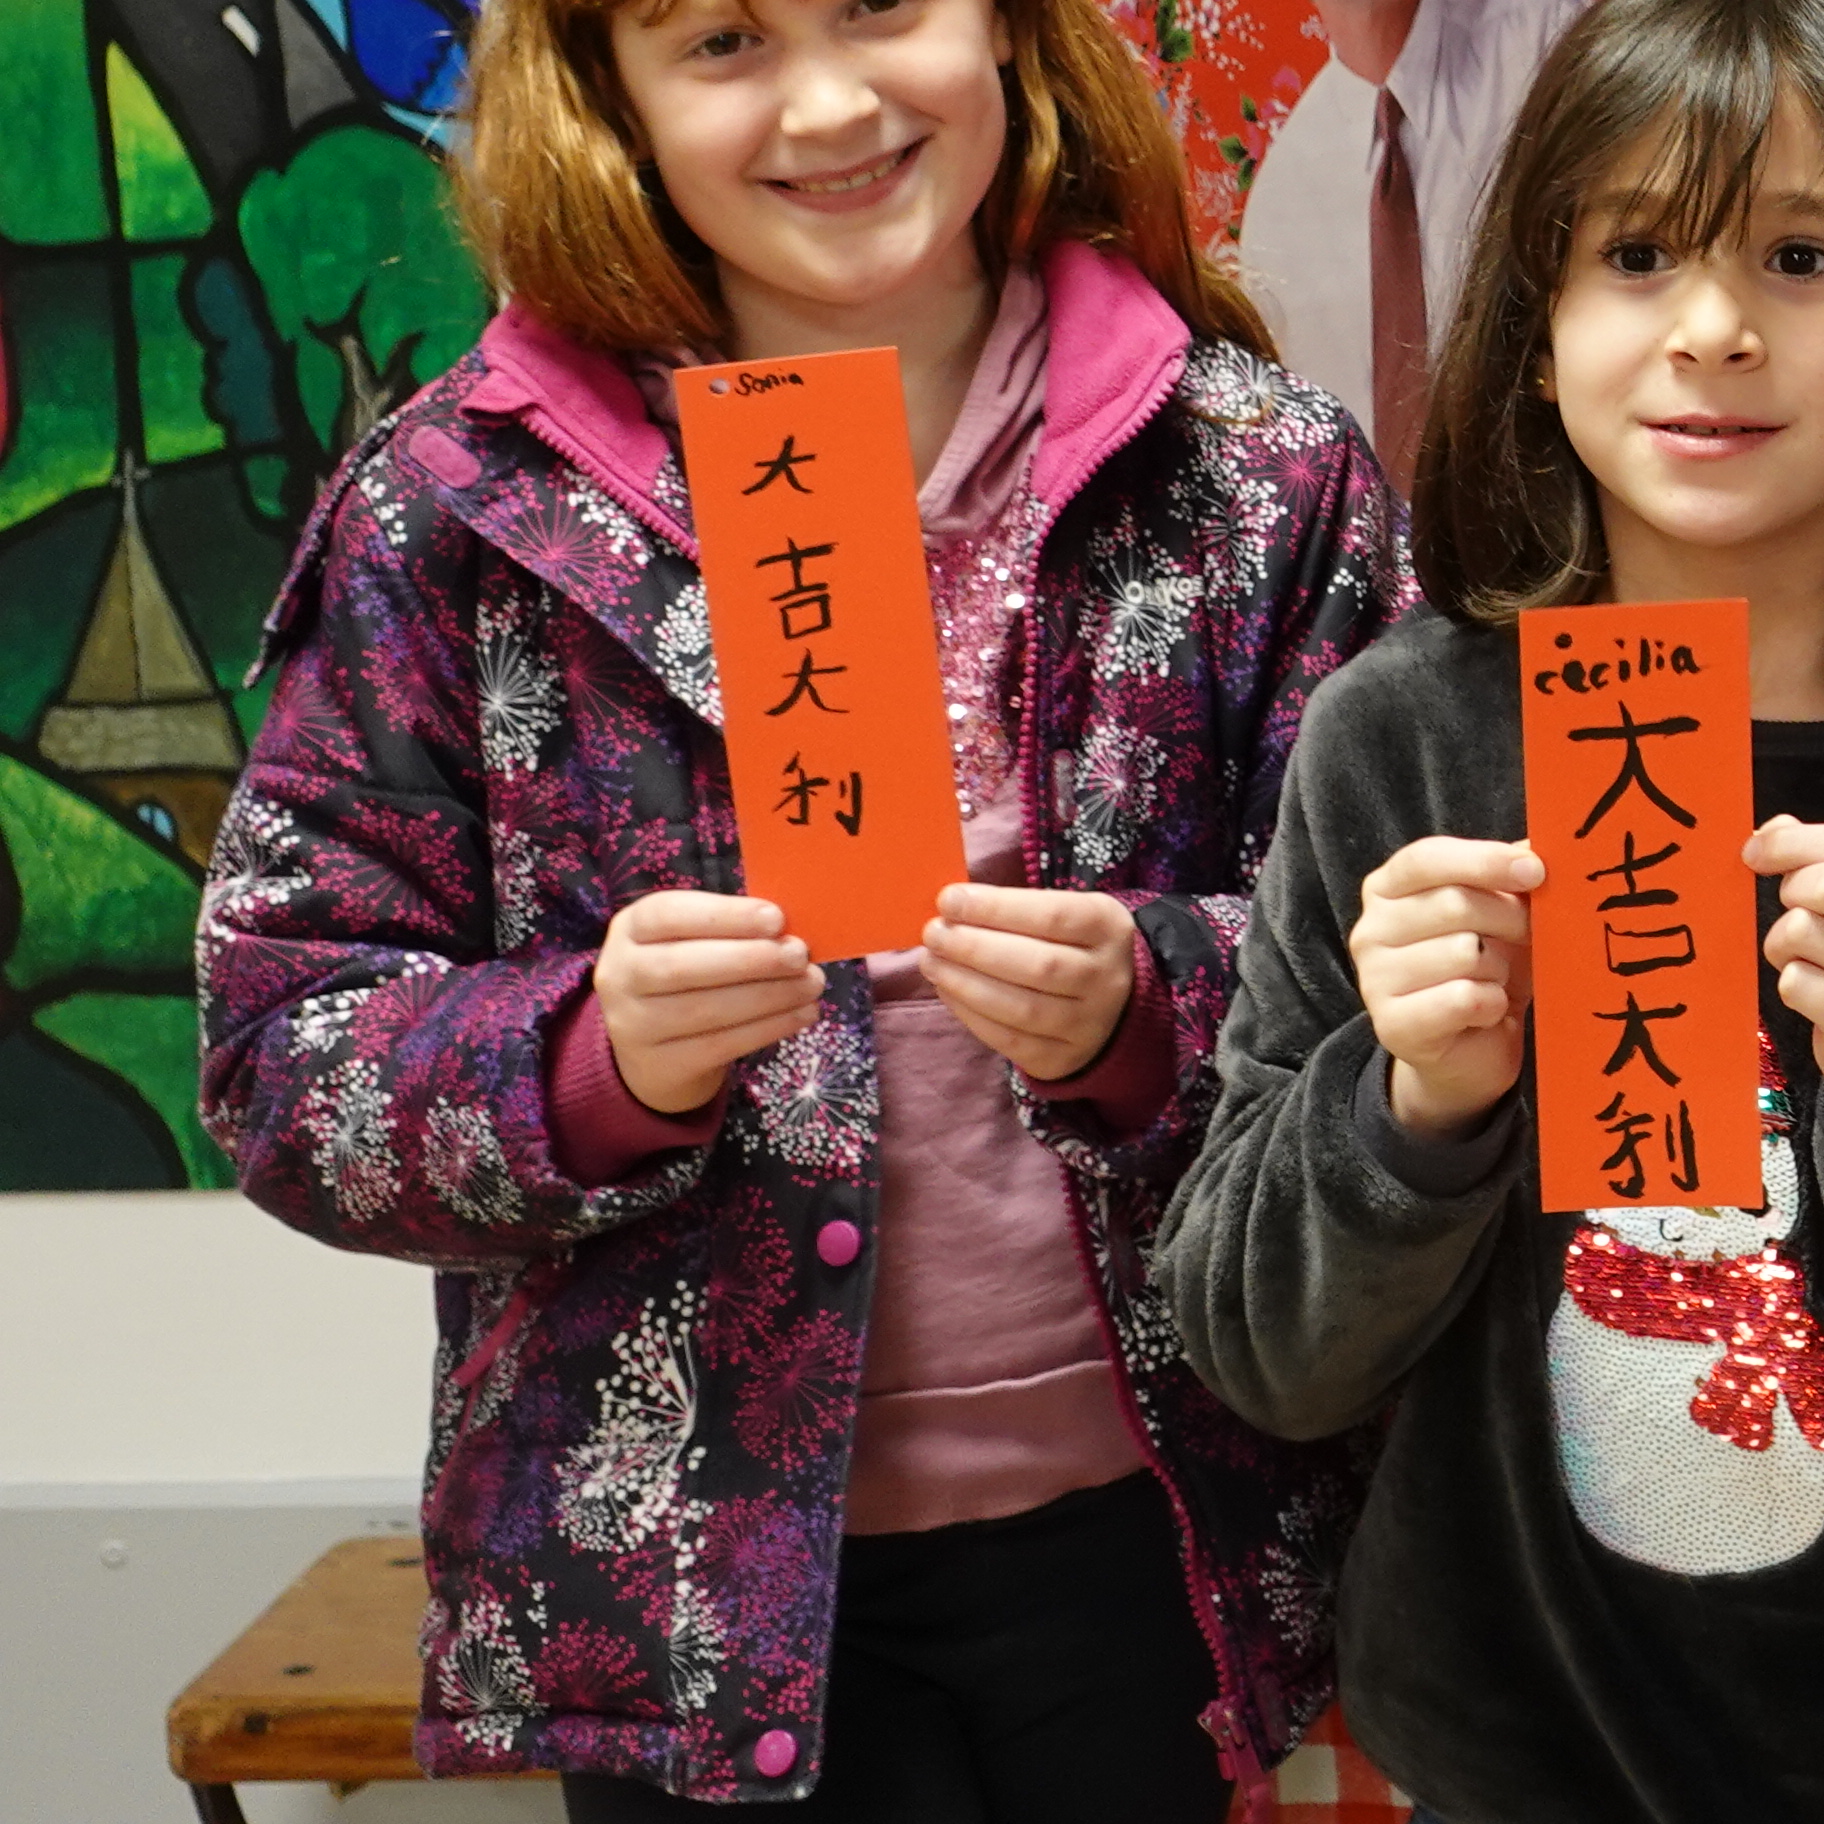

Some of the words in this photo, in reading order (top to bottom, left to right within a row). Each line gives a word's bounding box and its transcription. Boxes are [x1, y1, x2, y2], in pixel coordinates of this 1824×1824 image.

[741, 434, 862, 837] 大吉大利
[1568, 699, 1700, 1199] 大吉大利
